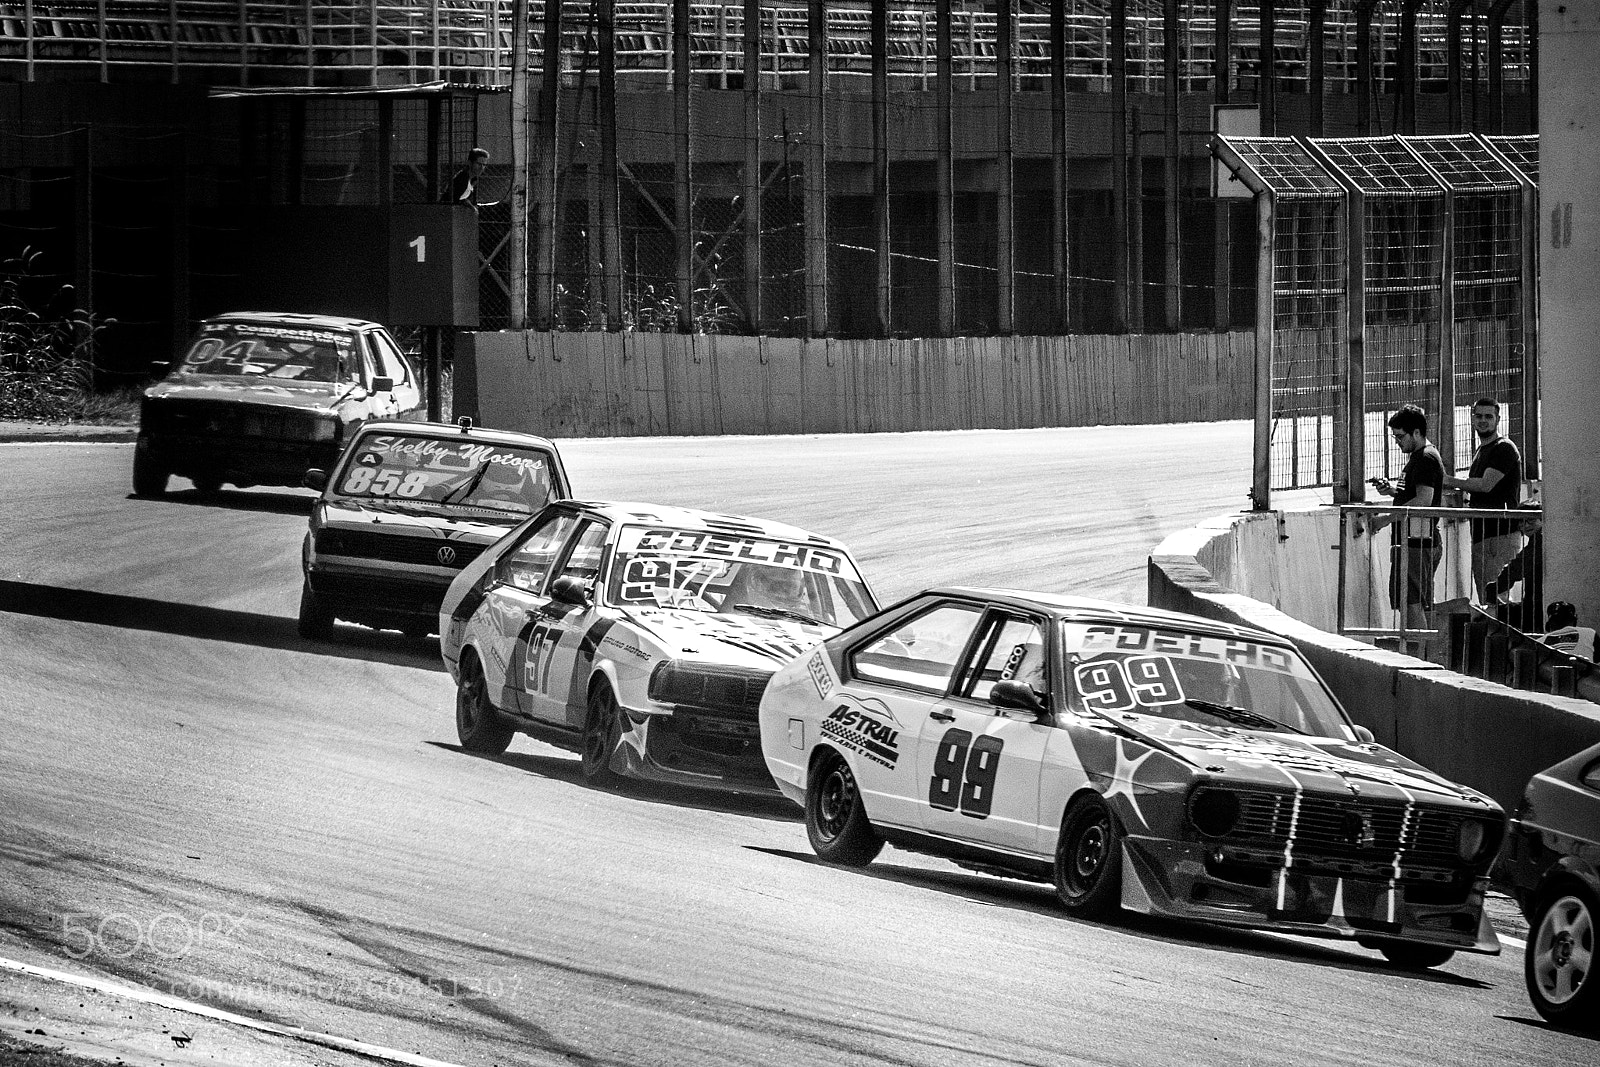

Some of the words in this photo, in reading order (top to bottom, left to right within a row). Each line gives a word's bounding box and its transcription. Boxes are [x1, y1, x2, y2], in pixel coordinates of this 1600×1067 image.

[409, 235, 426, 263] 1
[185, 337, 257, 366] 04
[361, 454, 376, 464] A
[369, 436, 451, 461] Shelby
[459, 443, 544, 470] Motors
[344, 466, 429, 497] 858
[636, 531, 842, 575] COELHO
[621, 557, 726, 607] 97
[524, 622, 565, 697] 97
[624, 644, 652, 661] MOTORS
[1000, 646, 1023, 681] arco
[1081, 626, 1292, 674] COELHO
[1074, 656, 1186, 713] 99
[828, 704, 899, 749] ASTRAL
[864, 752, 895, 771] PINTURA
[929, 727, 1004, 820] 99
